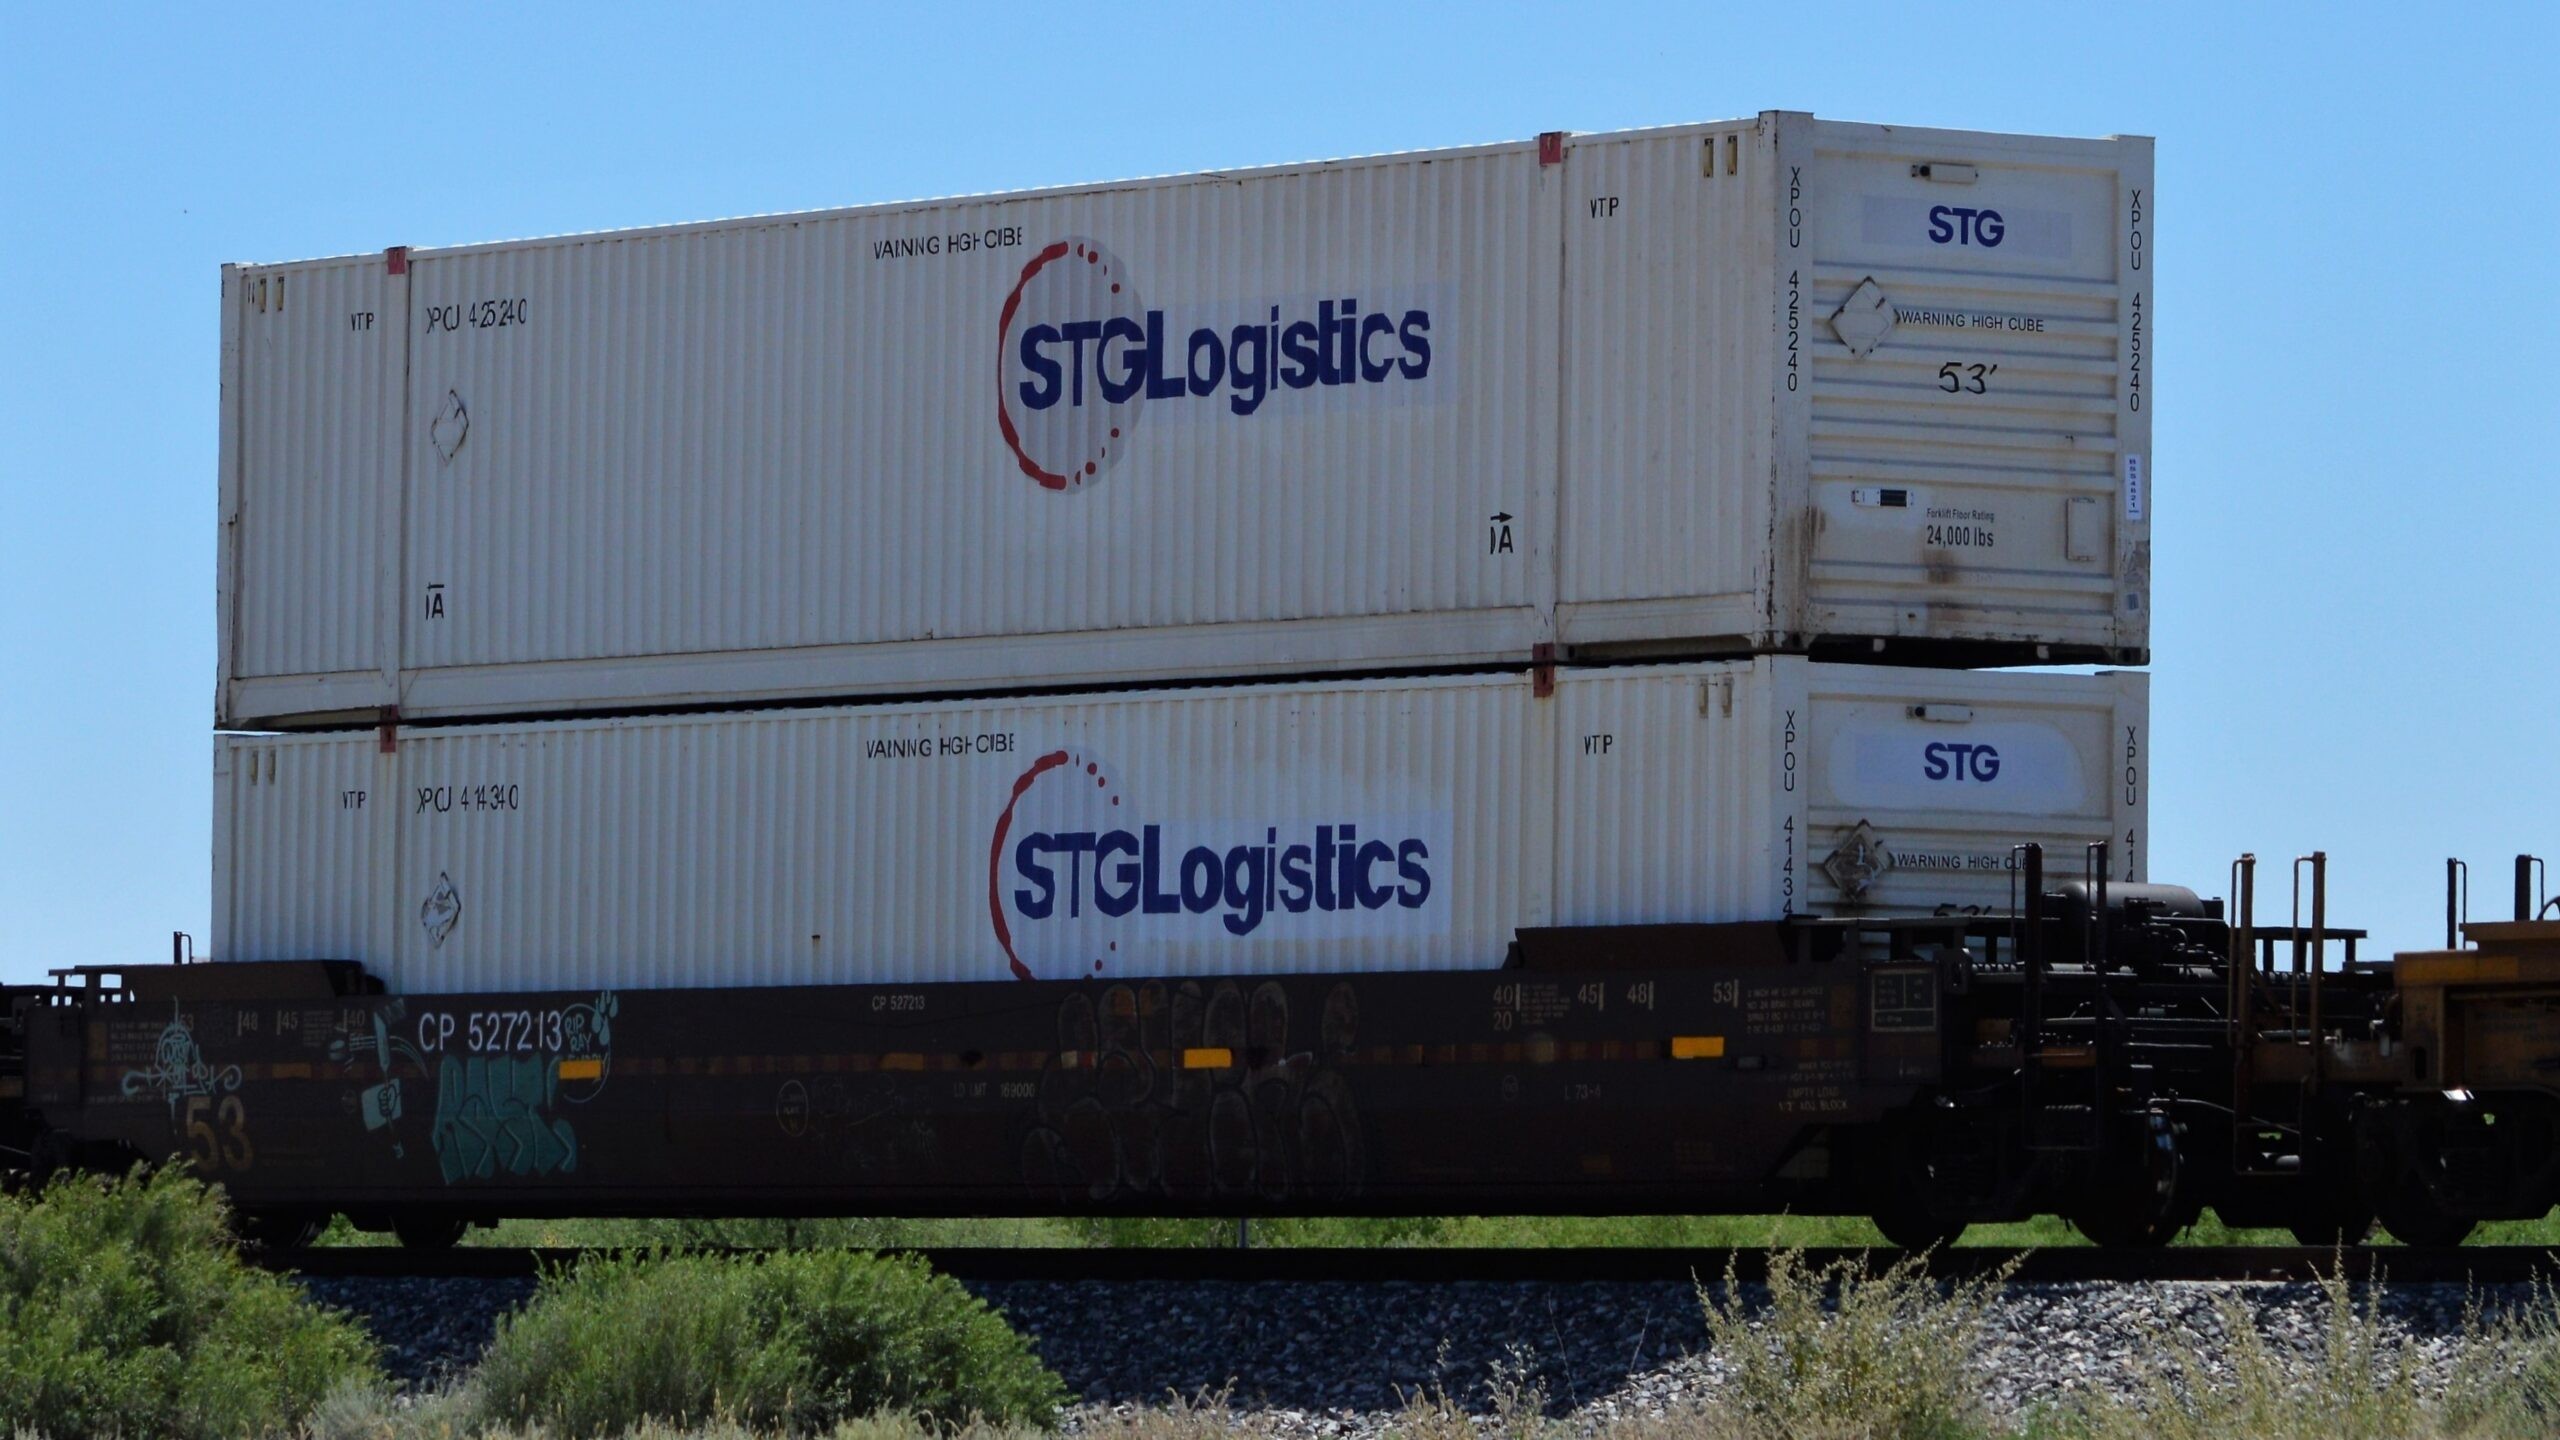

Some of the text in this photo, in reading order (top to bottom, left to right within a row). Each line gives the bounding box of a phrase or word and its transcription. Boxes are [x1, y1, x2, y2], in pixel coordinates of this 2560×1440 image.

[1590, 197, 1619, 218] VTP
[1928, 205, 2005, 247] STG
[1787, 167, 1800, 392] XPOU 425240
[2130, 190, 2141, 412] XPOU 425240
[351, 312, 374, 331] VTP
[1901, 311, 2044, 333] WARNING HIGH CUBE
[1926, 508, 1994, 523] Forklift Floor Rating
[1927, 524, 1994, 548] 24,000 lbs
[1584, 735, 1613, 755] VTP
[1924, 742, 2000, 782] STG
[2126, 726, 2136, 806] XPOU
[343, 790, 366, 809] VTP
[1783, 710, 1795, 913] XPOU 41434
[1898, 853, 1960, 869] WARNING
[1968, 855, 1999, 870] HIGH
[872, 994, 925, 1011] CP 527213
[1493, 985, 1513, 1004] 40
[1577, 984, 1597, 1004] 45
[1627, 983, 1649, 1004] 48
[1713, 982, 1734, 1003] 53
[418, 1010, 563, 1052] CP 527213
[1493, 1011, 1512, 1032] 20
[186, 1095, 254, 1172] 53
